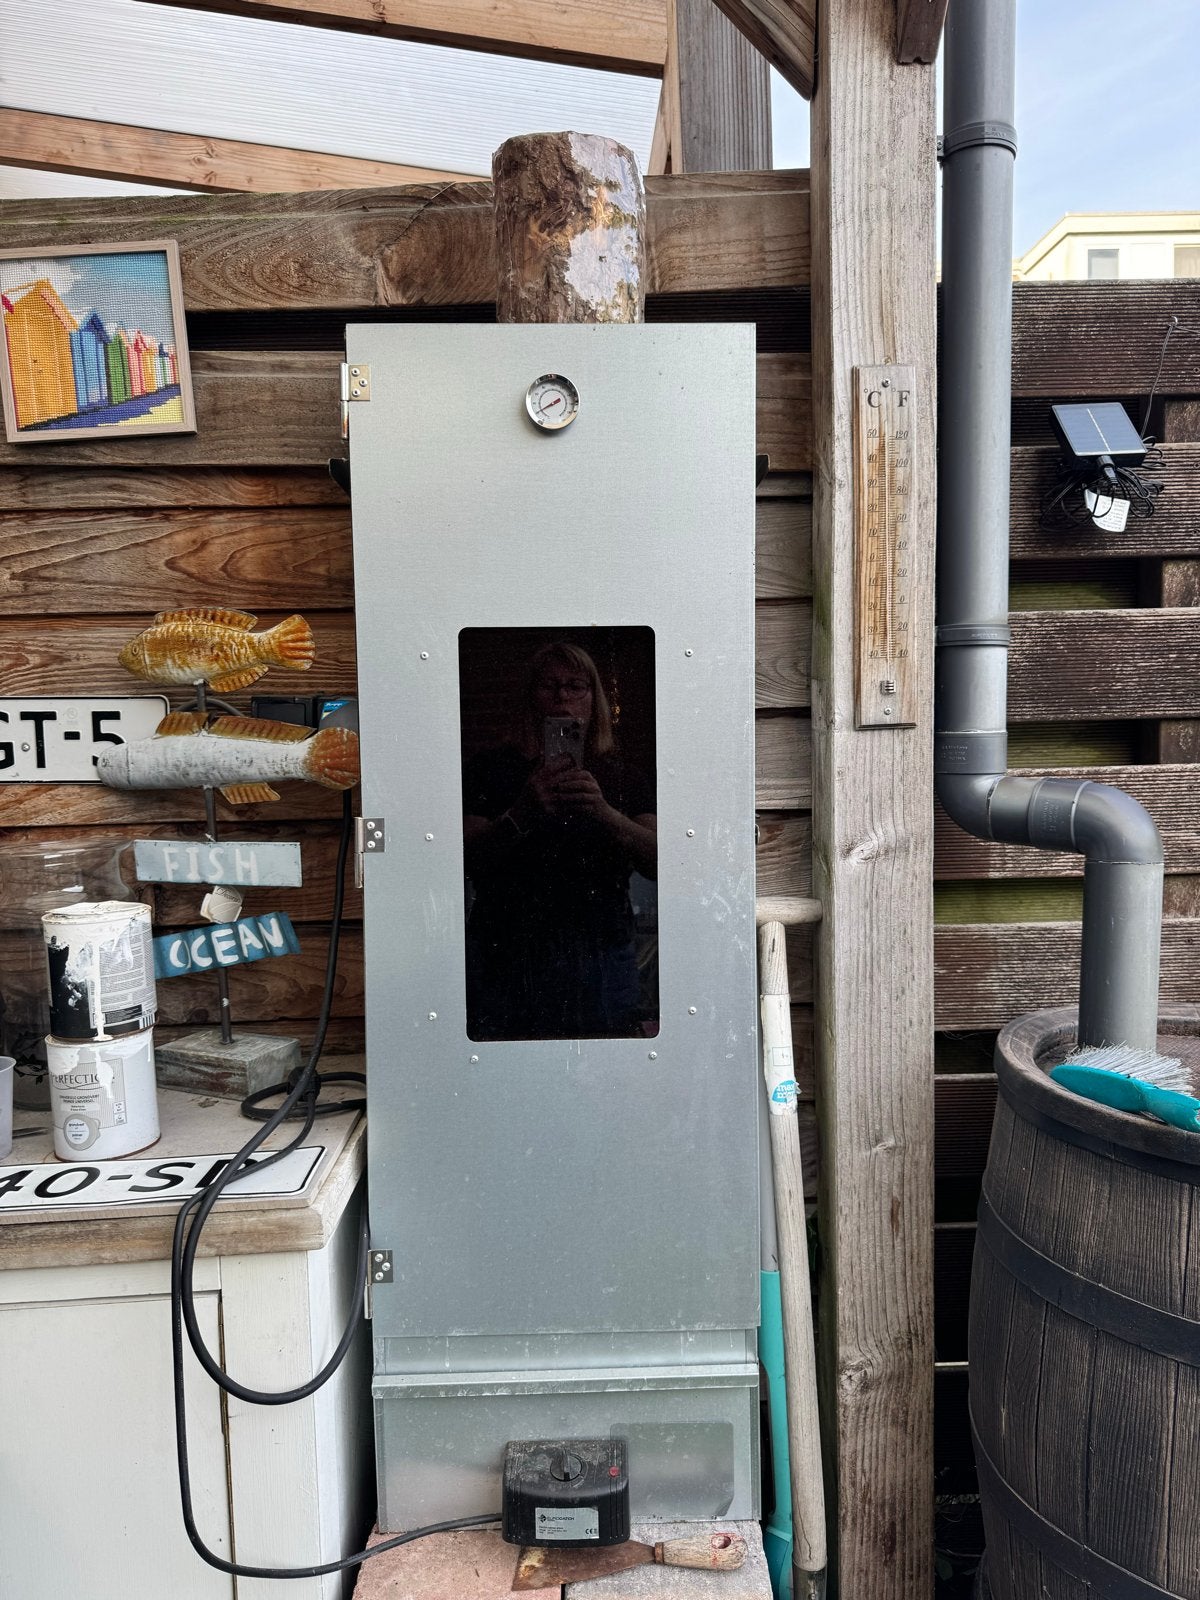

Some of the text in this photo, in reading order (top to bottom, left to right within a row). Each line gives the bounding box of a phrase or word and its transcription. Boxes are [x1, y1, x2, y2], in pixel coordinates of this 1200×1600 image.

[895, 430, 909, 439] 120
[895, 458, 909, 467] 100
[896, 485, 907, 494] 80
[868, 528, 878, 536] 10
[896, 541, 907, 549] 40
[869, 552, 875, 560] 0
[897, 567, 908, 576] 20
[899, 594, 905, 602] 0
[897, 621, 909, 630] 20
[897, 648, 909, 657] 40
[162, 846, 260, 886] FISH
[168, 917, 285, 970] OCEAN
[51, 1072, 115, 1085] PERFECTI
